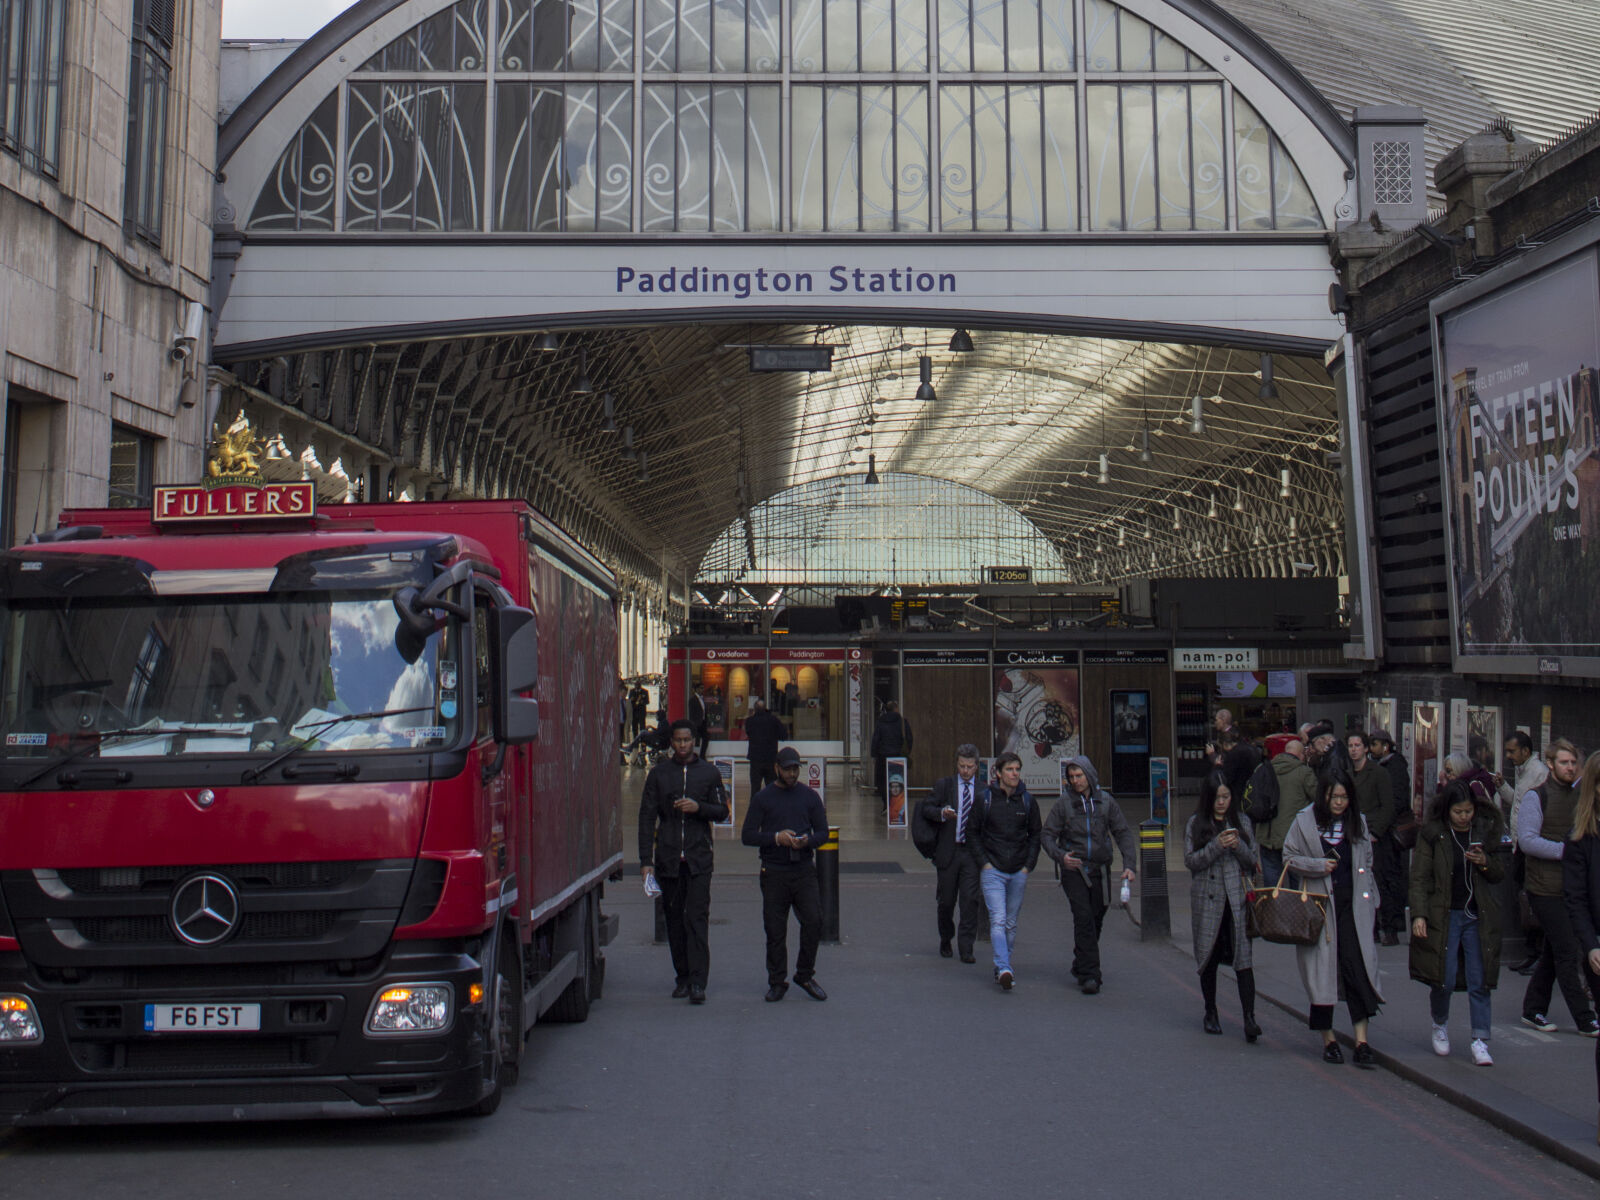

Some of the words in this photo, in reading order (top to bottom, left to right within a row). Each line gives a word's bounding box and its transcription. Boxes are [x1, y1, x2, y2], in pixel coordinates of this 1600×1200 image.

[616, 266, 813, 299] Paddington
[829, 265, 956, 293] Station
[1496, 367, 1513, 384] TRAIN
[1513, 361, 1529, 377] FROM
[1470, 374, 1576, 459] FIFTEEN
[1474, 448, 1580, 524] POUNDS
[162, 487, 304, 515] FULLER'S
[1553, 525, 1567, 542] ONE
[1567, 523, 1582, 539] WAY
[717, 649, 749, 657] vodafone
[789, 650, 825, 659] Paddington
[1183, 651, 1250, 663] nam-po!
[171, 1007, 197, 1026] F6
[203, 1007, 242, 1026] FST
